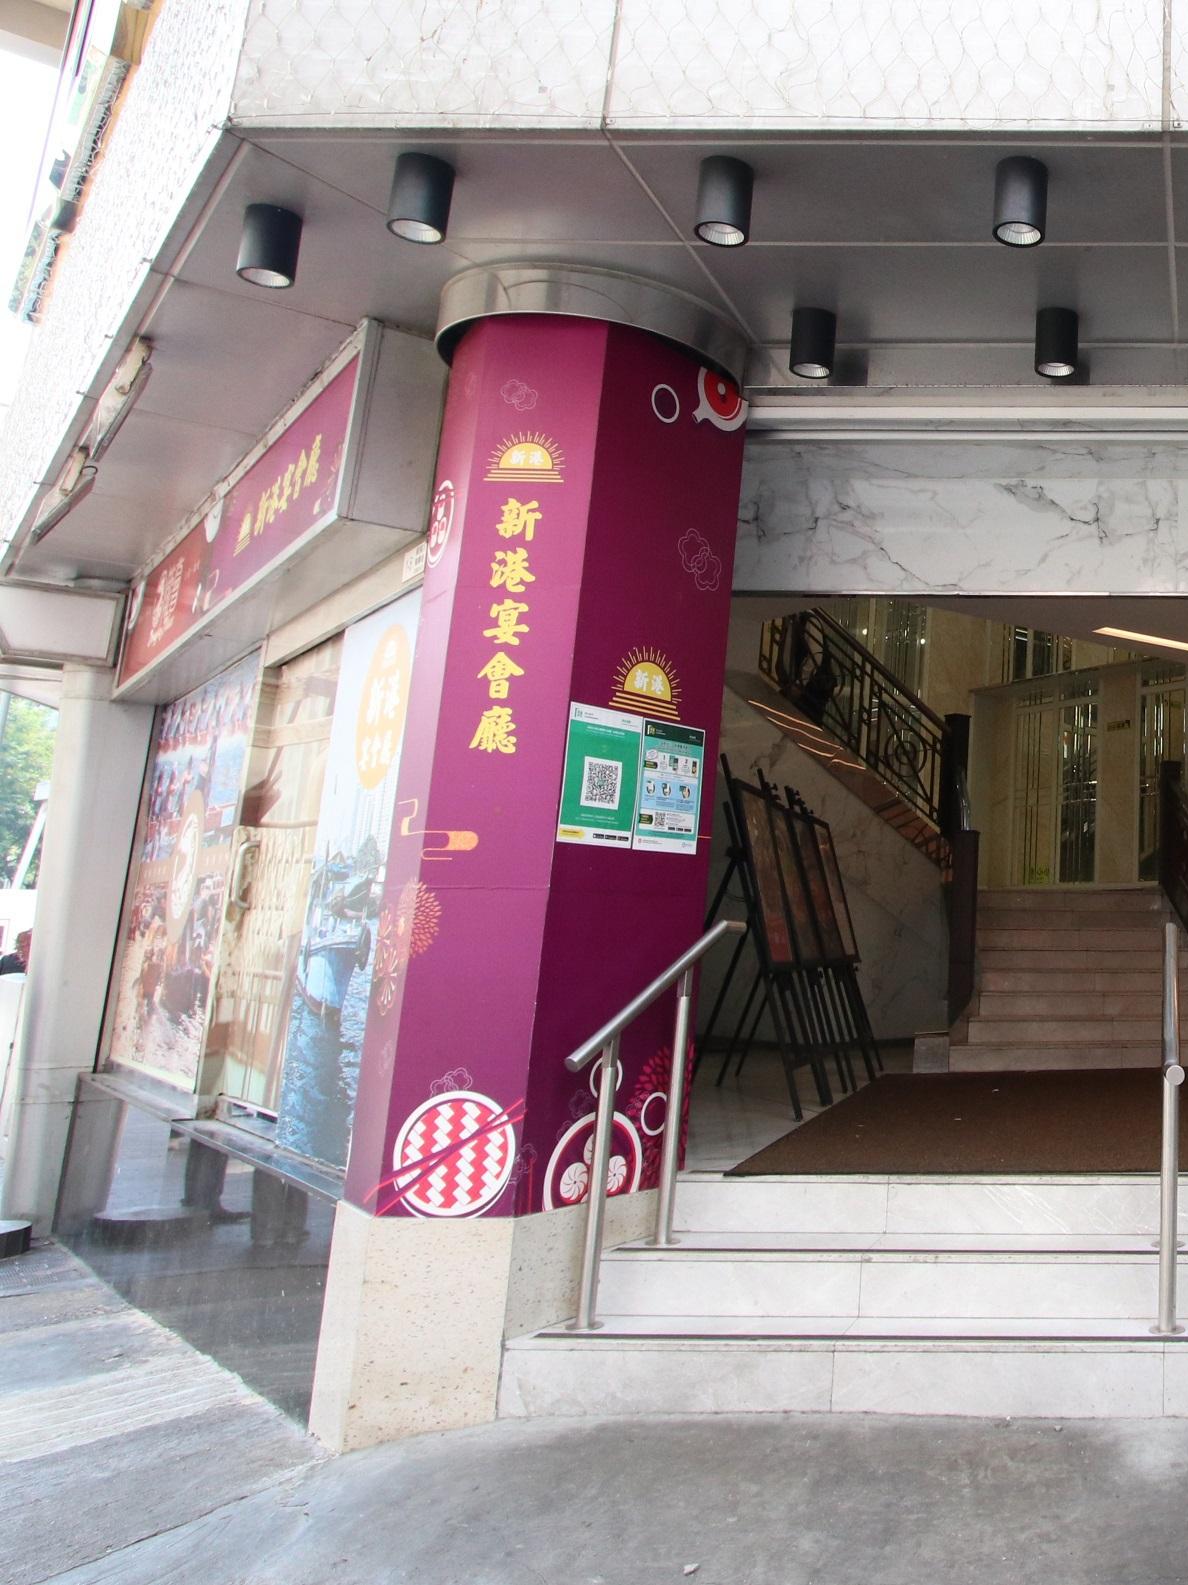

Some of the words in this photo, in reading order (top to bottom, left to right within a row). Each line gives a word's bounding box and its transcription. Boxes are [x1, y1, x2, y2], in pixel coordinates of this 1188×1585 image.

[254, 433, 322, 536] 新港宴會廳
[469, 498, 542, 754] 新港宴會廳
[634, 668, 665, 695] 新港
